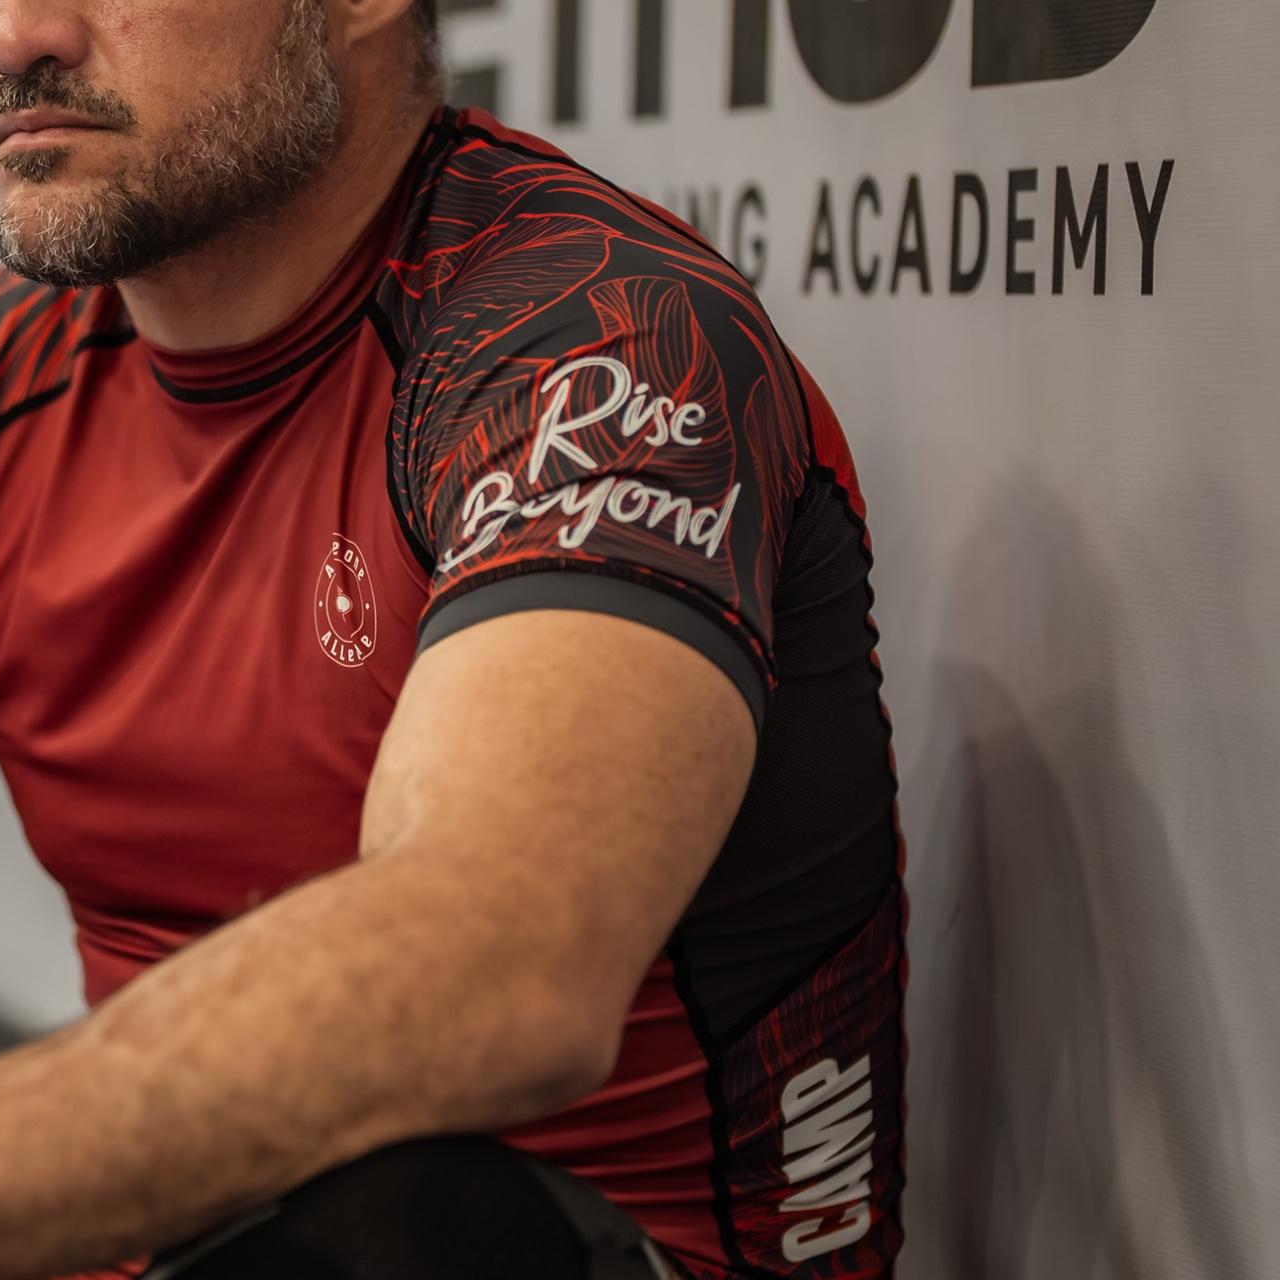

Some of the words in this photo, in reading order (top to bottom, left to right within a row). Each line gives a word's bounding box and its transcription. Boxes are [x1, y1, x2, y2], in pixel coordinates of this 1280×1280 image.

[801, 159, 1176, 297] ACADEMY
[528, 355, 707, 485] Rise
[436, 470, 742, 573] Beyond
[778, 1053, 877, 1264] CAMP
